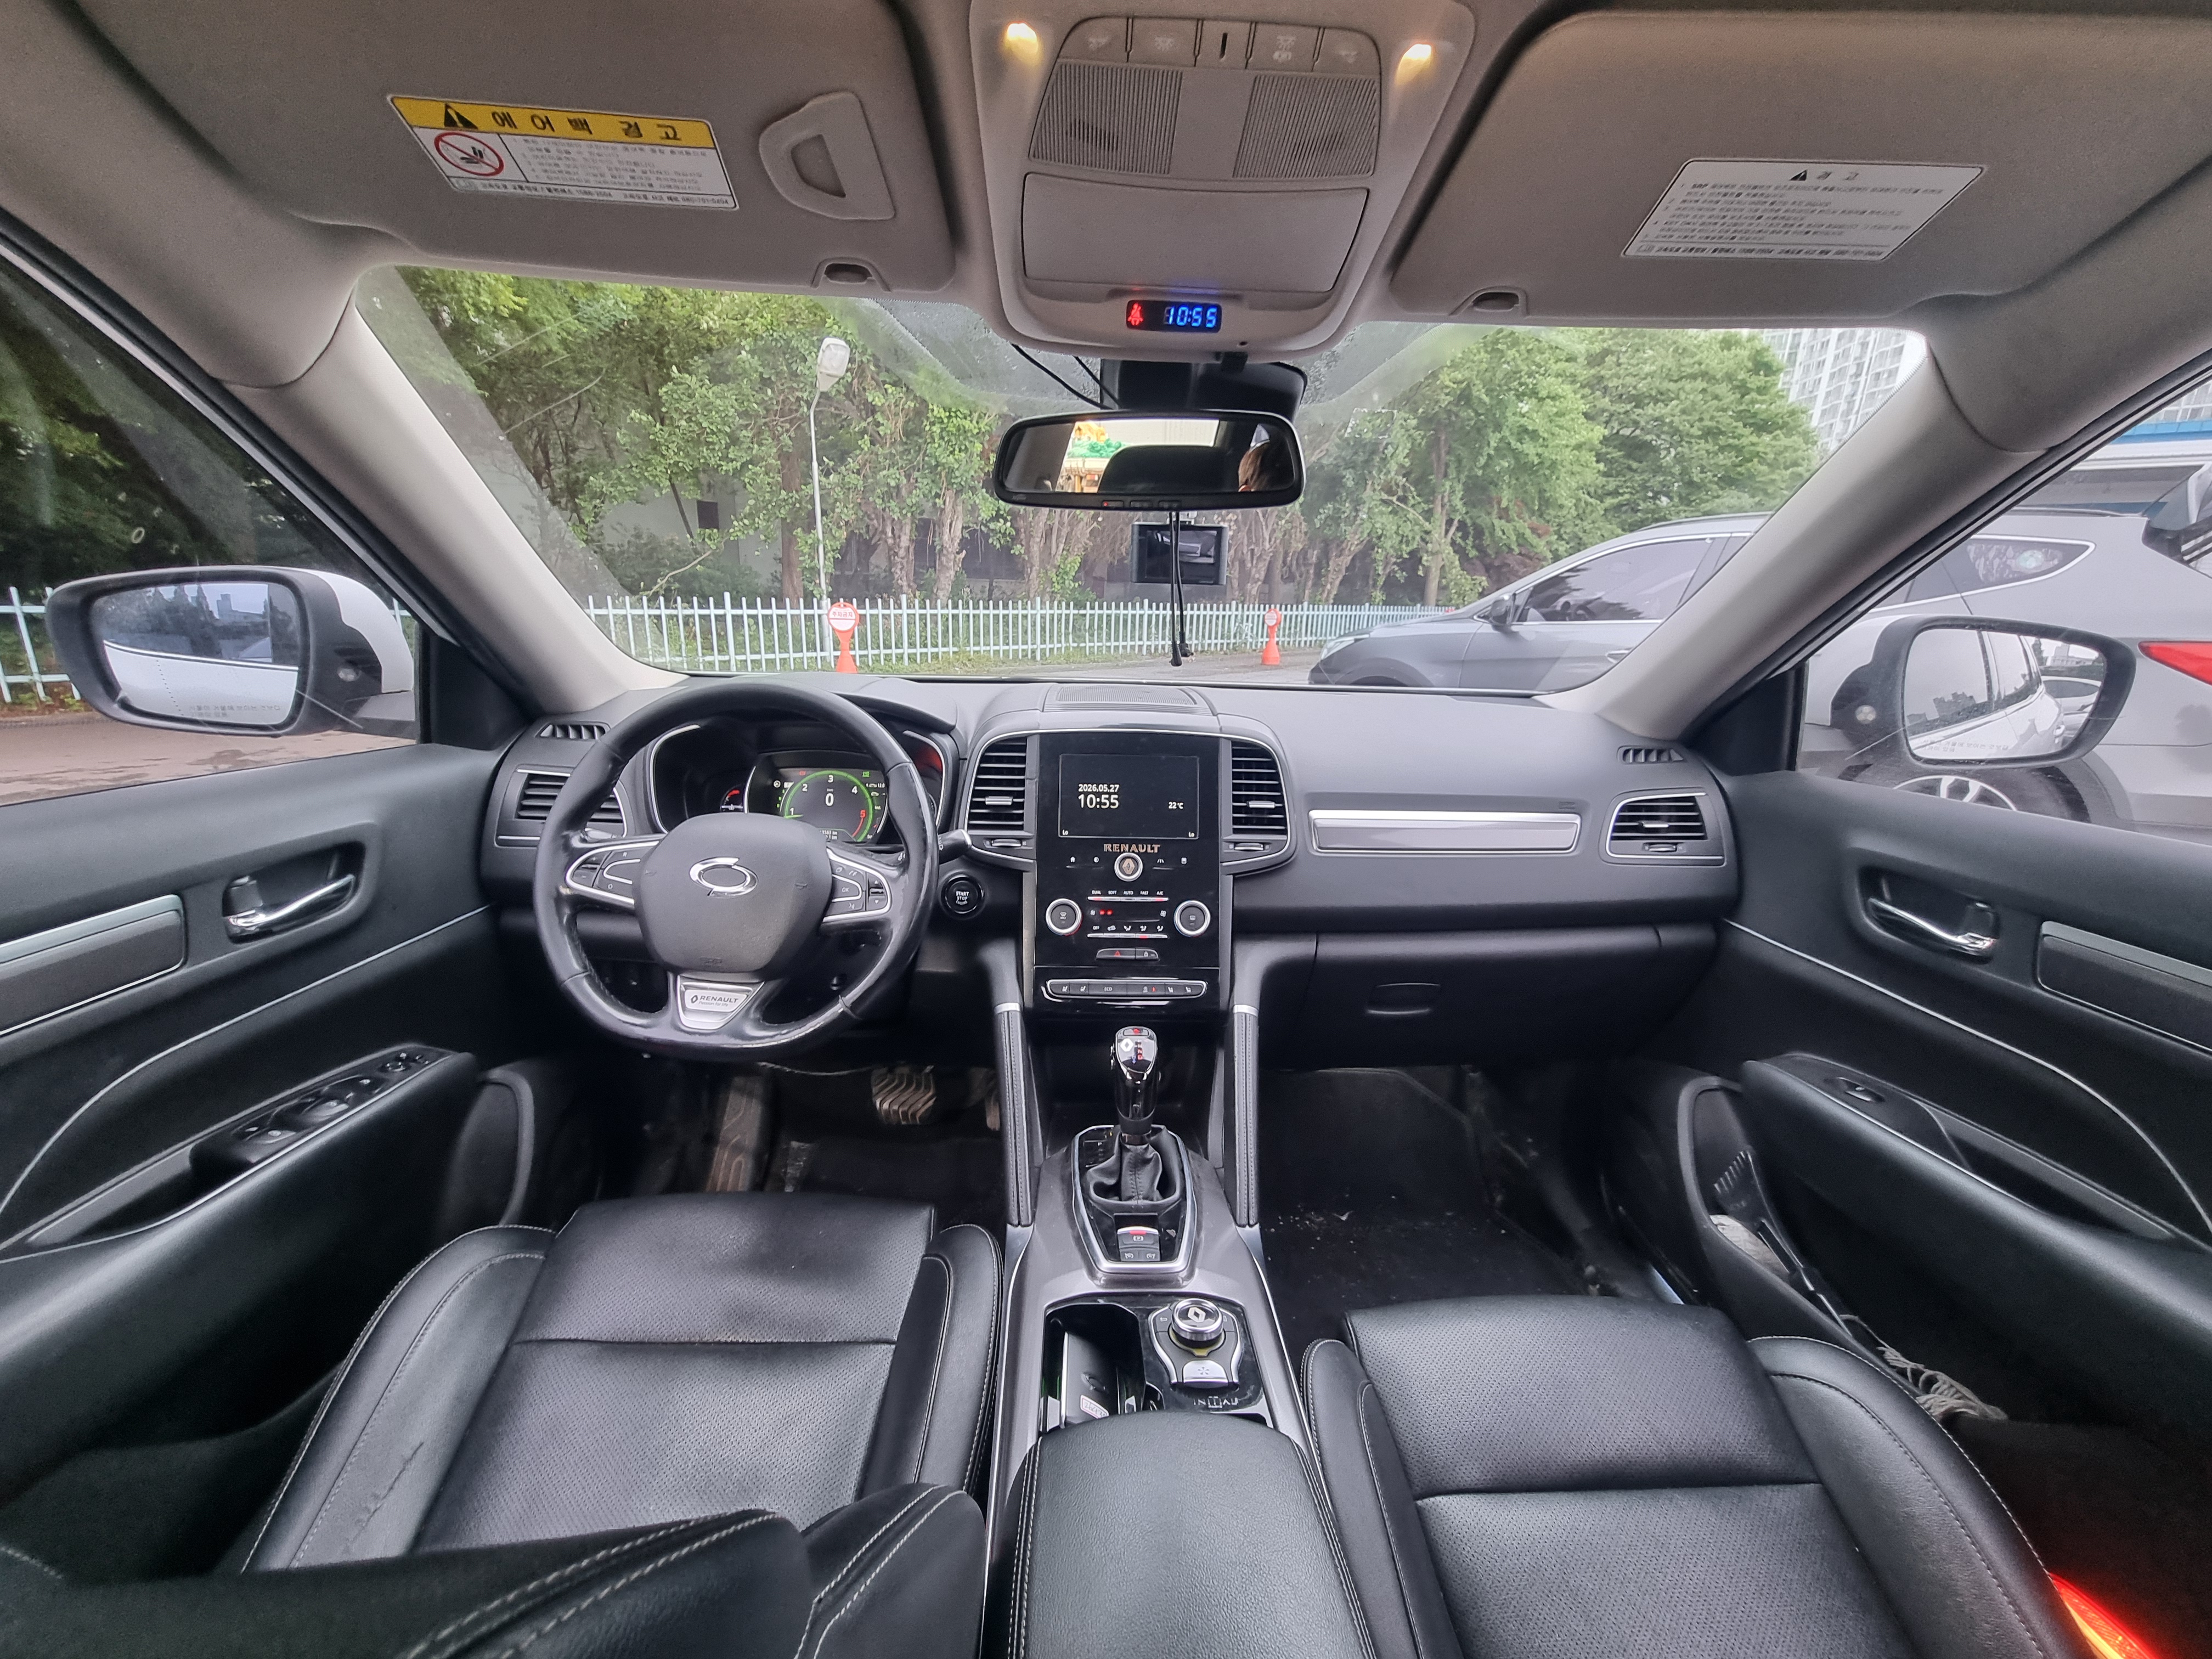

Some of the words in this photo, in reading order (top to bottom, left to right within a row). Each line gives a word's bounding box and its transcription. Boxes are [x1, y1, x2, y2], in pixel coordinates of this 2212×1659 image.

[1168, 305, 1218, 328] 10:55
[828, 775, 833, 783] 3
[851, 786, 857, 794] 4
[1078, 784, 1120, 793] 2026.05.27
[825, 793, 834, 806] 0
[1078, 794, 1119, 809] 10:55
[860, 809, 866, 817] 5
[1104, 844, 1160, 853] RENAULT
[699, 995, 739, 1003] RENAULT
